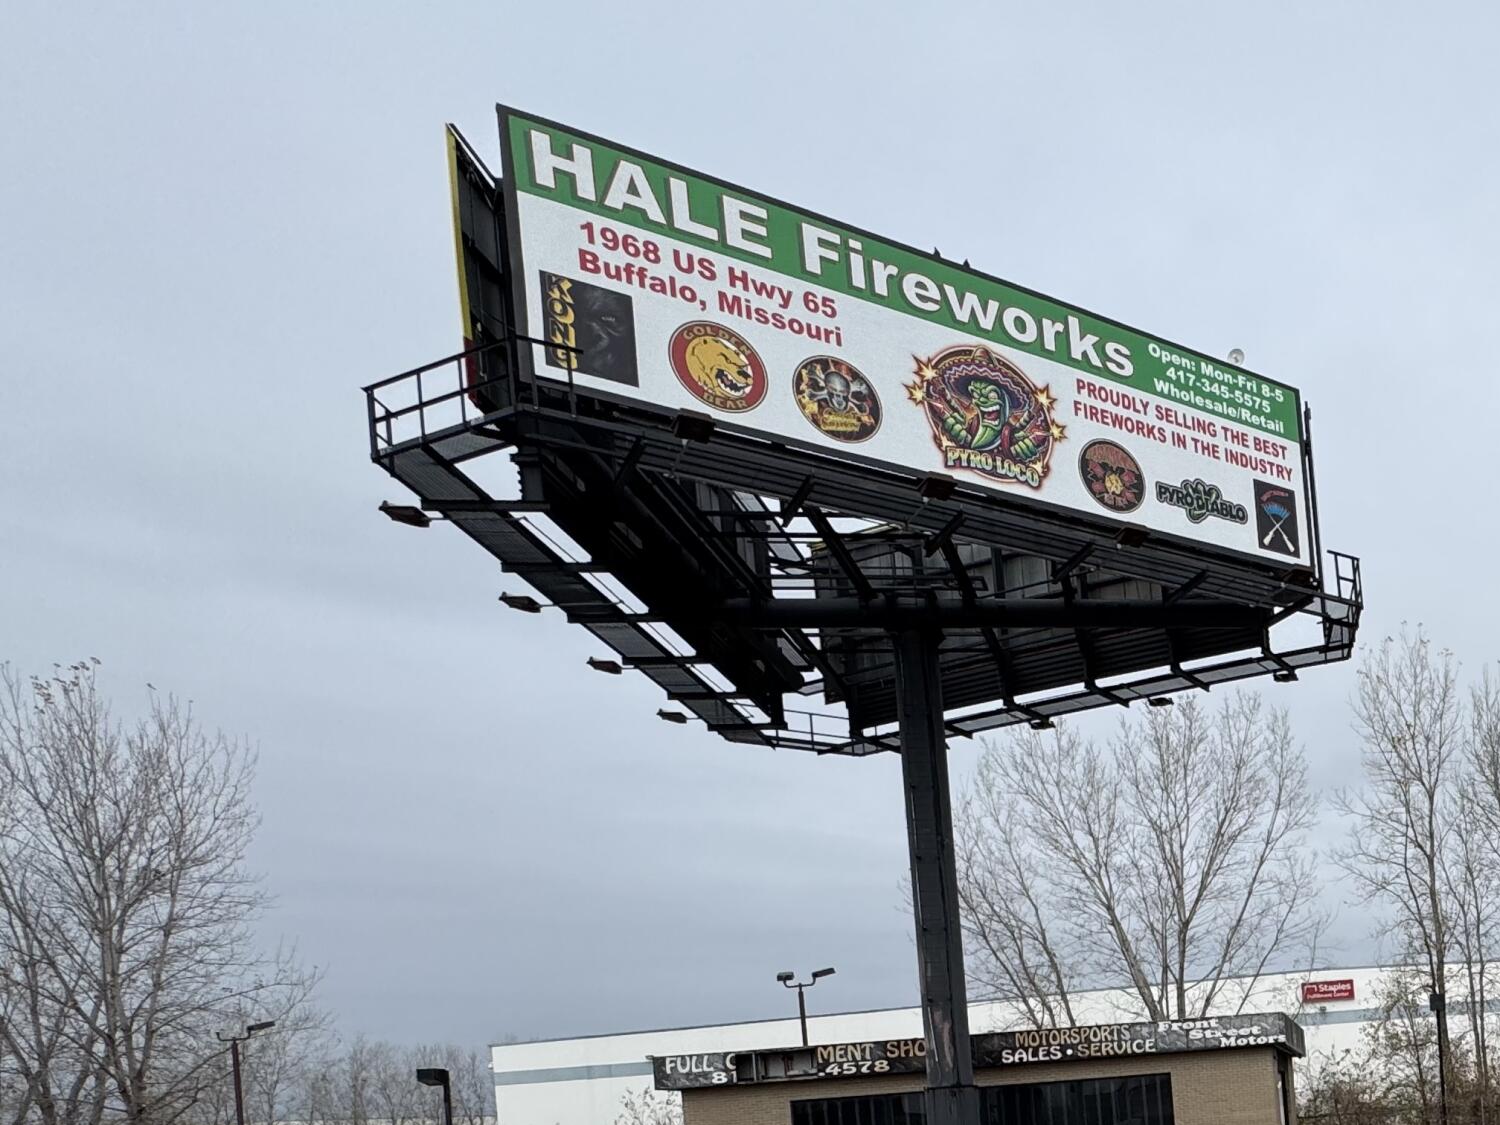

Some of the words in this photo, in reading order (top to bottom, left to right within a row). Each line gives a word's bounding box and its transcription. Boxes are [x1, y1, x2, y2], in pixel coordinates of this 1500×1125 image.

[529, 129, 773, 259] HALE
[801, 222, 1134, 377] Fireworks
[580, 222, 661, 264] 1968
[673, 249, 717, 281] US
[728, 266, 793, 309] Hwy
[803, 291, 838, 318] 65
[578, 248, 707, 311] Buffalo,
[718, 290, 843, 347] Missouri
[683, 326, 751, 356] GOLDEN
[1148, 343, 1196, 371] Open:
[1200, 361, 1258, 393] Mon-Fri
[1262, 383, 1284, 402] 8-5
[1166, 367, 1271, 413] 417-345-5575
[703, 391, 748, 409] BEAR
[1076, 378, 1150, 416] PROUDLY
[1155, 404, 1217, 438] SELLING
[1221, 426, 1249, 449] THE
[1253, 436, 1288, 460] BEST
[1153, 378, 1285, 434] Wholesale/Retail
[1073, 400, 1167, 443] FIREWORKS
[1171, 430, 1187, 449] IN
[1191, 437, 1220, 460] THE
[1225, 445, 1293, 482] INDUSTRY
[946, 447, 993, 471] PYRO
[996, 456, 1041, 488] LOCO
[1158, 484, 1195, 507] PYRO
[1196, 494, 1247, 524] DIABLO
[1318, 982, 1352, 996] Staples
[1014, 1024, 1131, 1048] MOTORSPORTS
[1157, 1018, 1220, 1033] Front
[1188, 1025, 1261, 1039] Street
[1219, 1034, 1287, 1048] Motors
[665, 1054, 714, 1074] FULL
[886, 1040, 926, 1058] SHO
[1001, 1046, 1063, 1063] SALES
[1077, 1039, 1156, 1057] SERVICE
